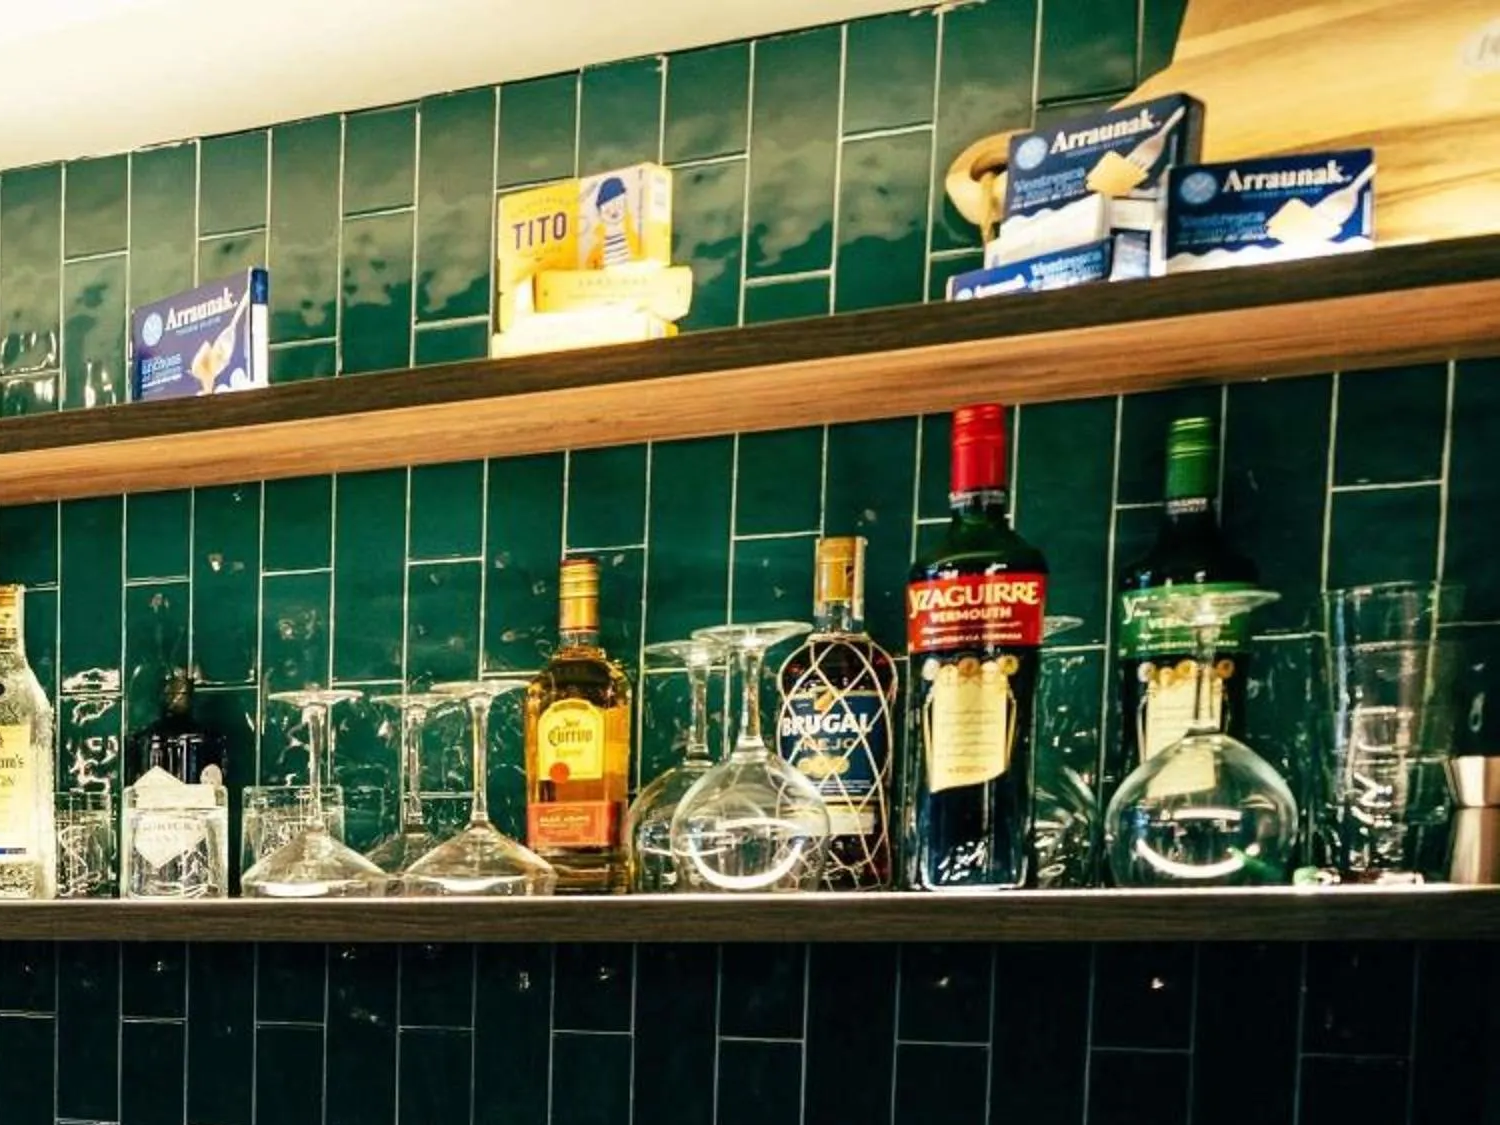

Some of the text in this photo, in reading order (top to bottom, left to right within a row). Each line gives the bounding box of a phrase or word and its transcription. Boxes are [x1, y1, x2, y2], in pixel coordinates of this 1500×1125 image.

[1051, 108, 1156, 154] Arraunak
[1222, 159, 1344, 193] Arraunak
[513, 211, 567, 250] TITO
[908, 581, 1040, 619] YZAGUIRRE
[782, 713, 873, 736] BRUGAL
